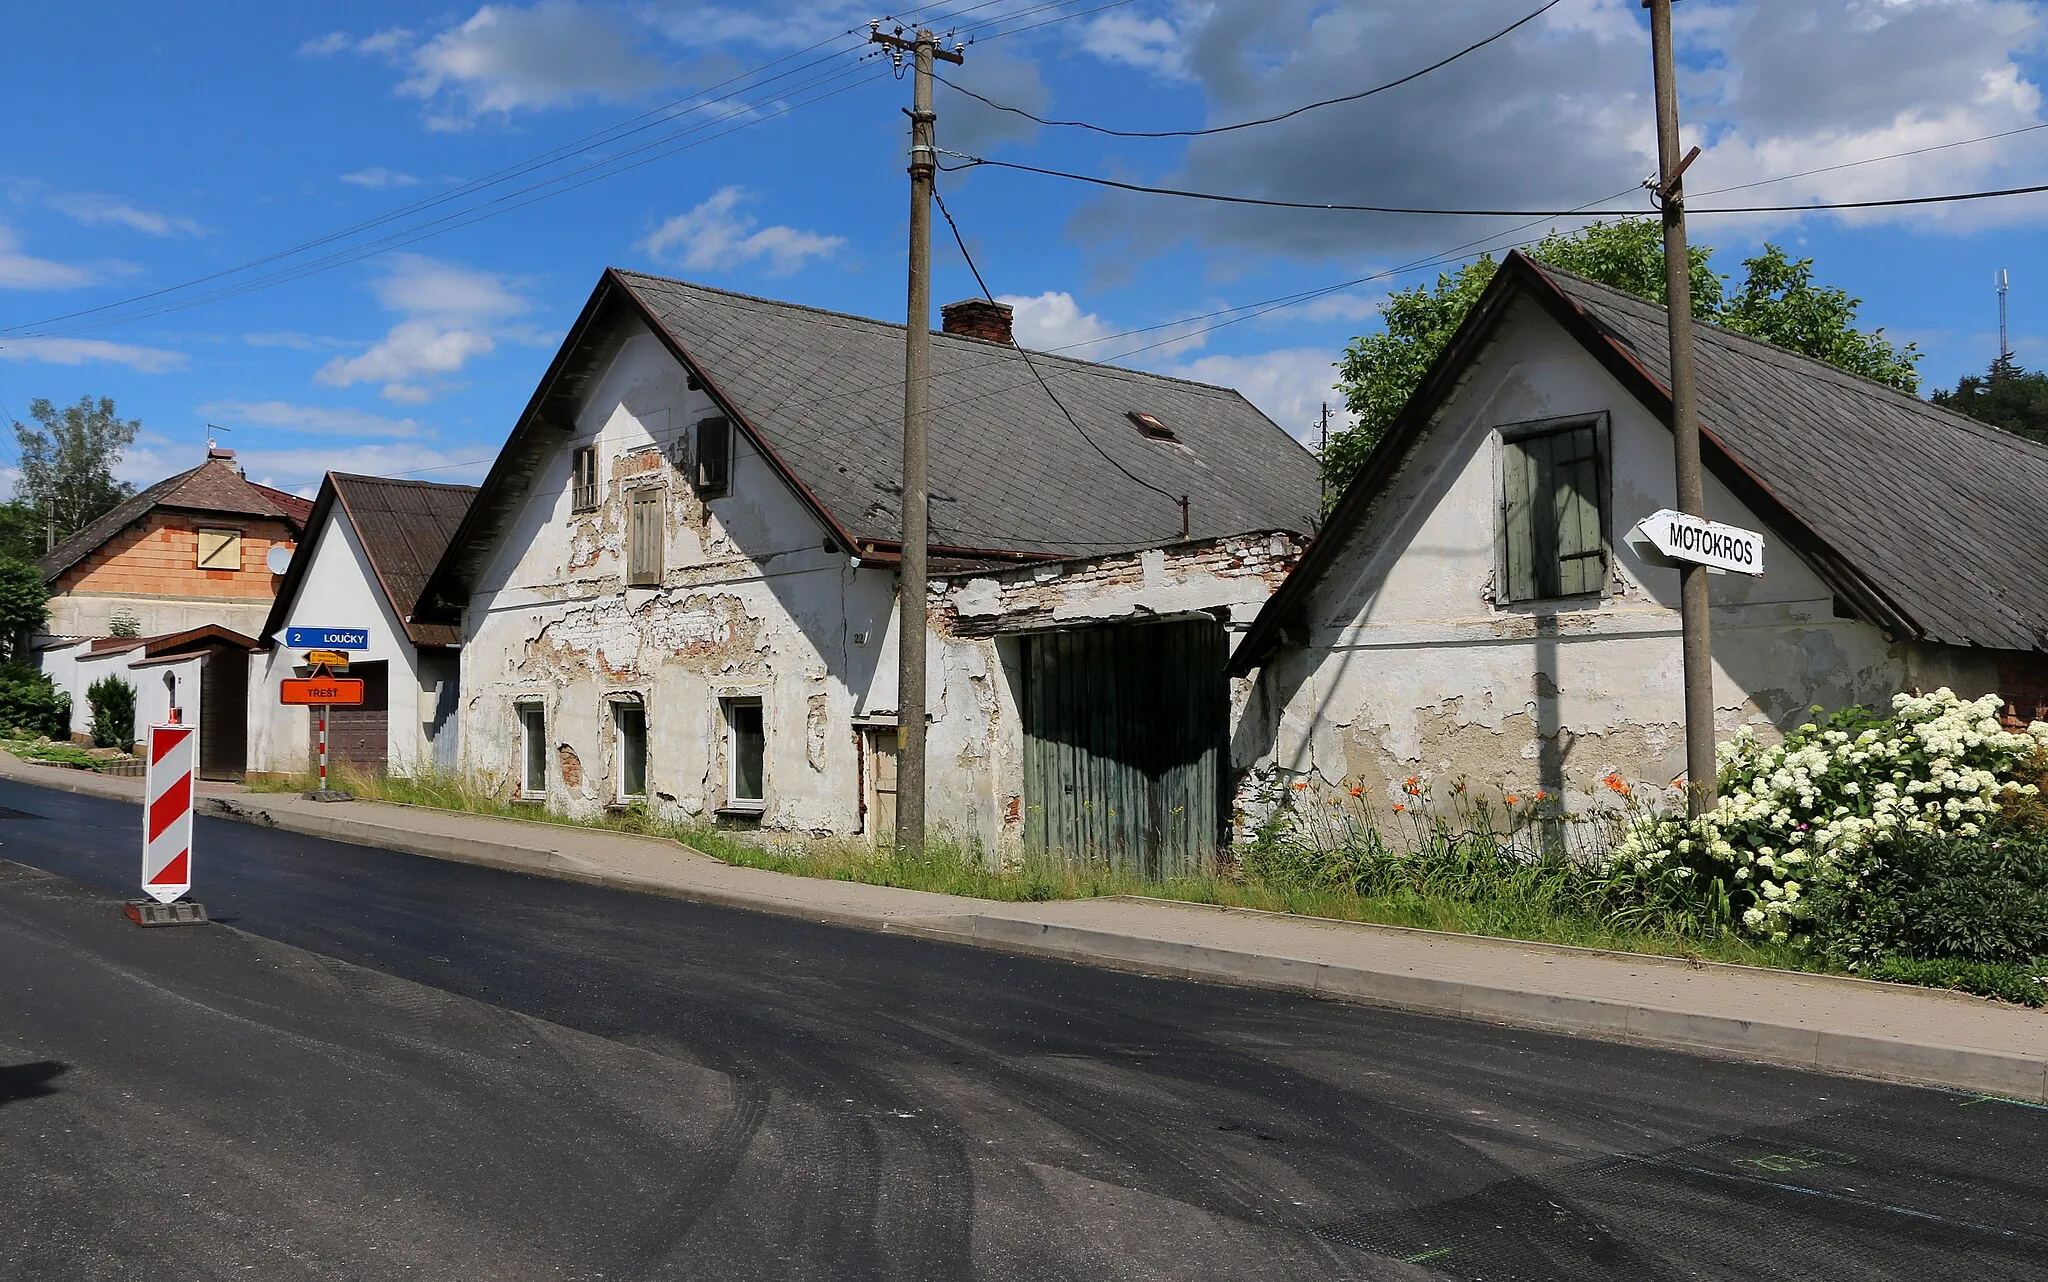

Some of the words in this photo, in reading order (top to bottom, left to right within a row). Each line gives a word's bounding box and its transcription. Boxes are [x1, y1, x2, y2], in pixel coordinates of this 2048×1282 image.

[1669, 522, 1753, 565] MOTOKROS
[294, 633, 302, 642] 2
[323, 633, 365, 644] LOUČKY
[308, 688, 339, 698] TŘEŠŤ
